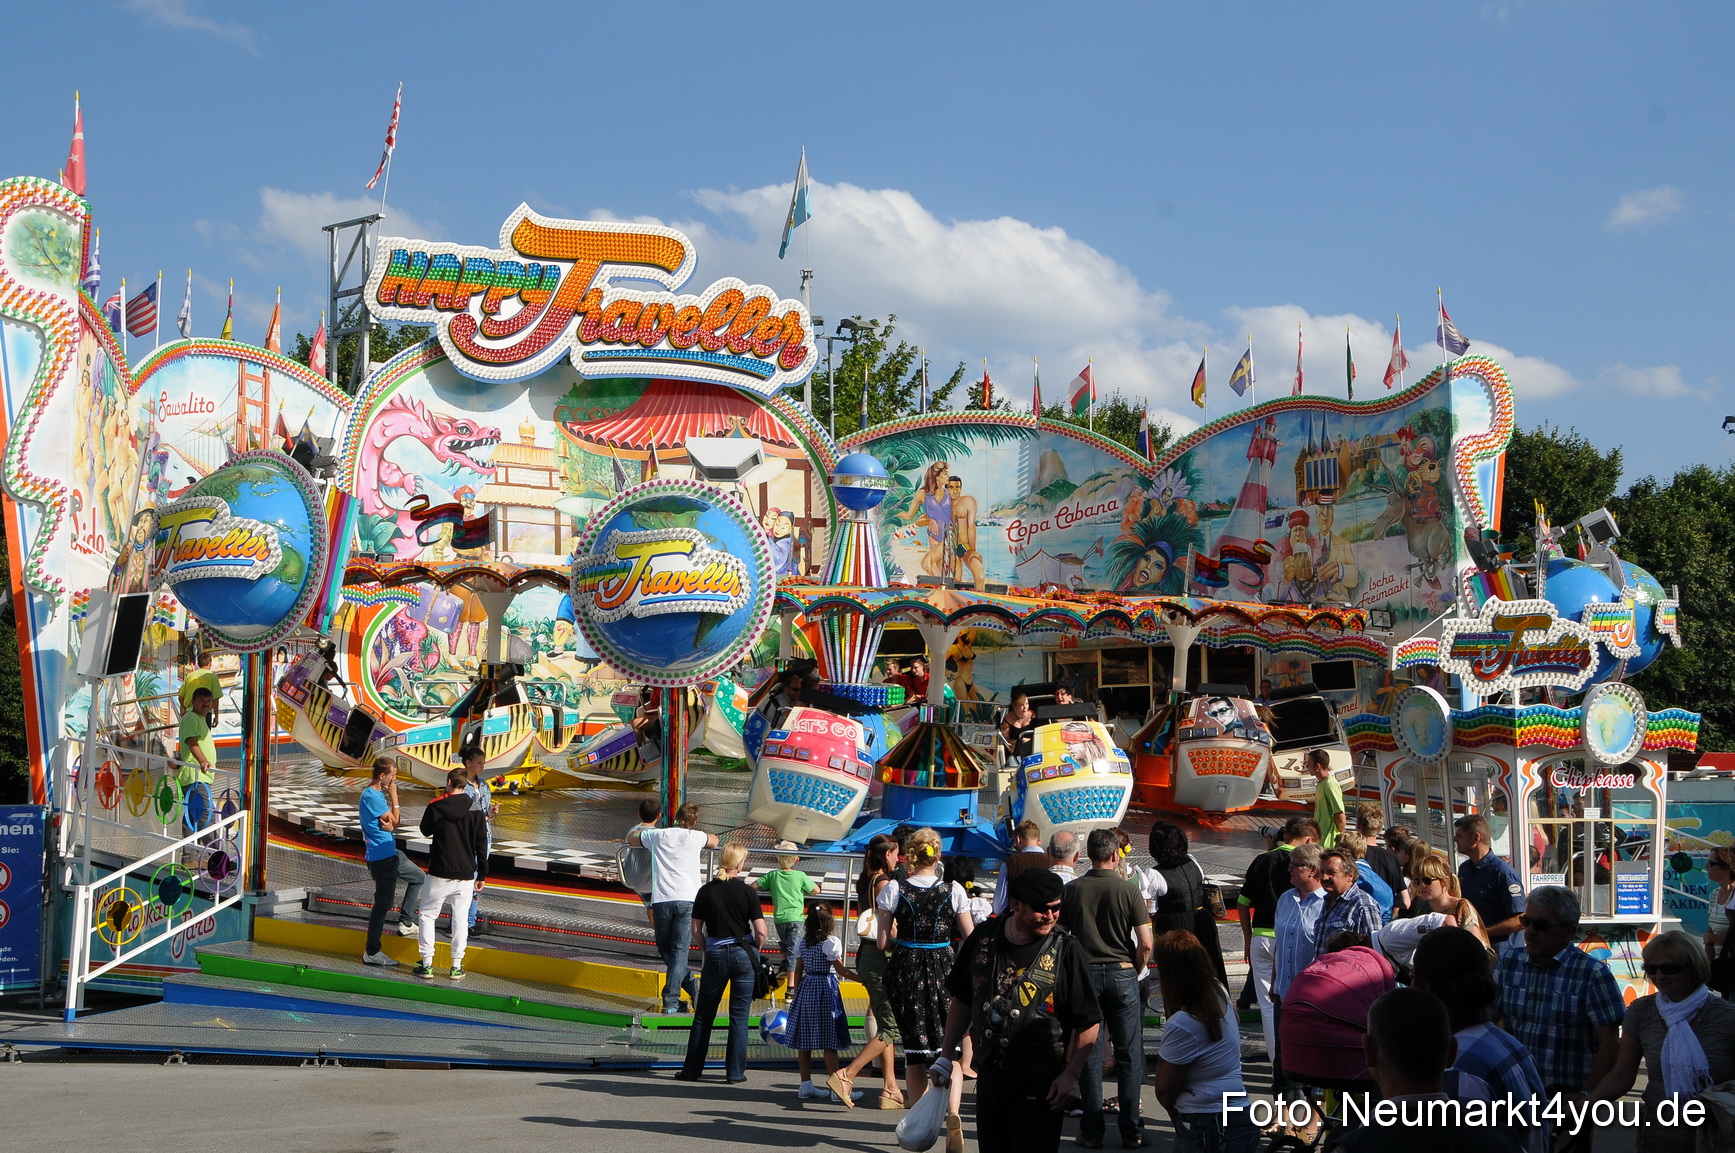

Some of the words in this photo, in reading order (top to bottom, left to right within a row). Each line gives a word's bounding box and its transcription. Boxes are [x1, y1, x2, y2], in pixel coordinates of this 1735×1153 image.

[377, 249, 562, 337] HAPPY
[448, 216, 809, 370] Traveller
[158, 391, 215, 422] Sausalito
[153, 507, 271, 578] Traveller
[1005, 517, 1051, 543] Copa
[1054, 499, 1119, 529] Cabana
[594, 539, 743, 612] Traveller
[1471, 612, 1593, 682] Traveller
[790, 717, 829, 735] LET'S
[830, 723, 858, 740] GO
[1551, 767, 1635, 796] Chipkasse
[1, 846, 20, 854] Sie:
[1532, 874, 1564, 883] FAHRPREIS
